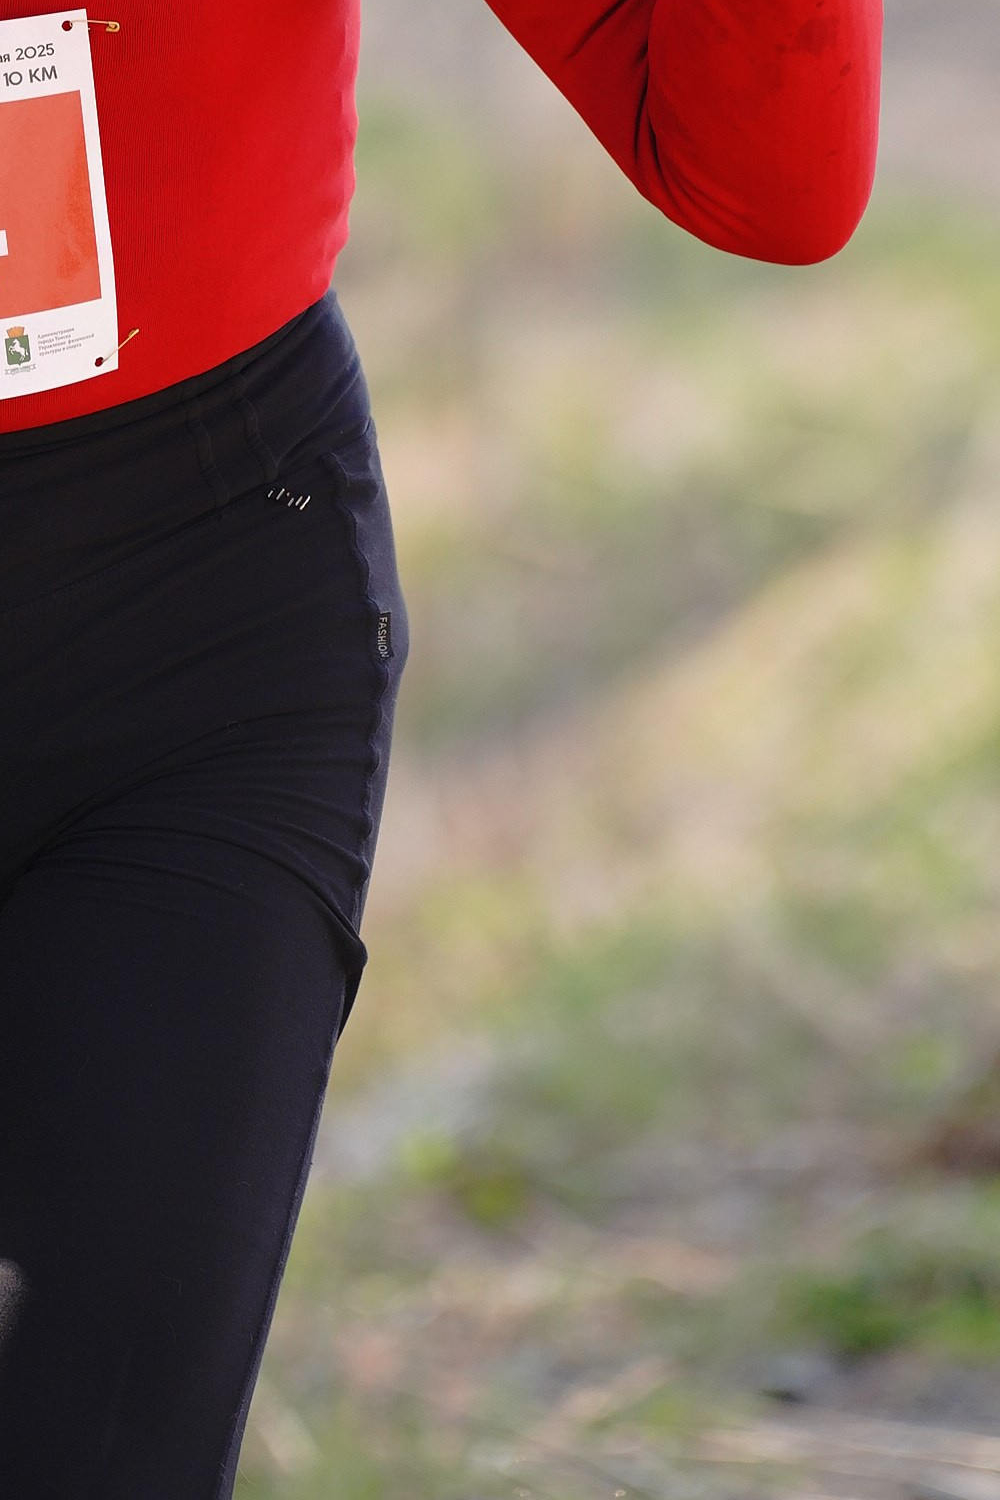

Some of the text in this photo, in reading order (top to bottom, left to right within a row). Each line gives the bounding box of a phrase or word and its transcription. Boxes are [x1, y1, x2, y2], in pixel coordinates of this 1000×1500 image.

[15, 43, 55, 61] 2025
[2, 65, 59, 87] 10 КМ
